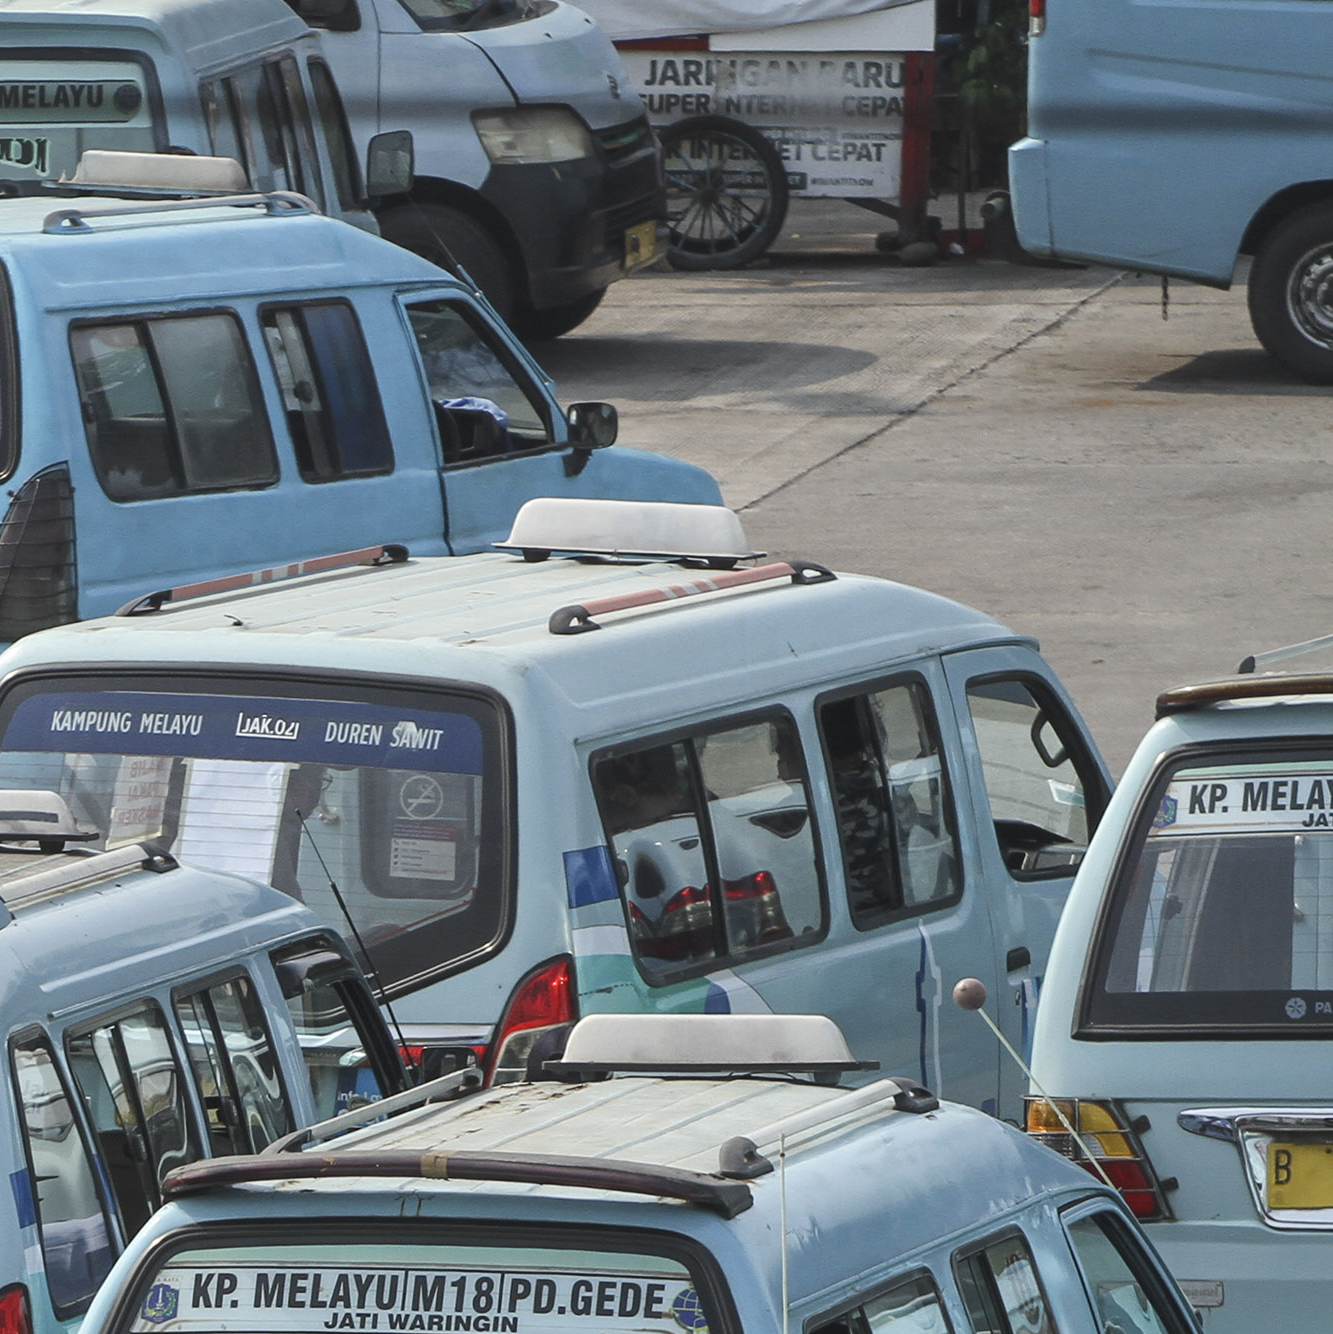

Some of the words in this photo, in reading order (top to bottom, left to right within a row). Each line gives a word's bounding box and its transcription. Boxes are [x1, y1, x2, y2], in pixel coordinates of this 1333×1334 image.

[842, 95, 904, 116] CEPA
[51, 711, 132, 732] KAMPUNG
[139, 713, 203, 735] MELAYU
[325, 722, 382, 745] DUREN
[390, 725, 444, 750] SAWIT
[1189, 784, 1229, 814] KP.
[1242, 778, 1333, 812] MELA
[1275, 1150, 1291, 1185] B
[192, 1273, 236, 1309] KP.
[253, 1274, 400, 1312] MELAYU
[407, 1276, 499, 1315] M18
[510, 1279, 667, 1319] PD.GEDE
[324, 1312, 378, 1330] JATI
[388, 1314, 518, 1333] WARINGIN
